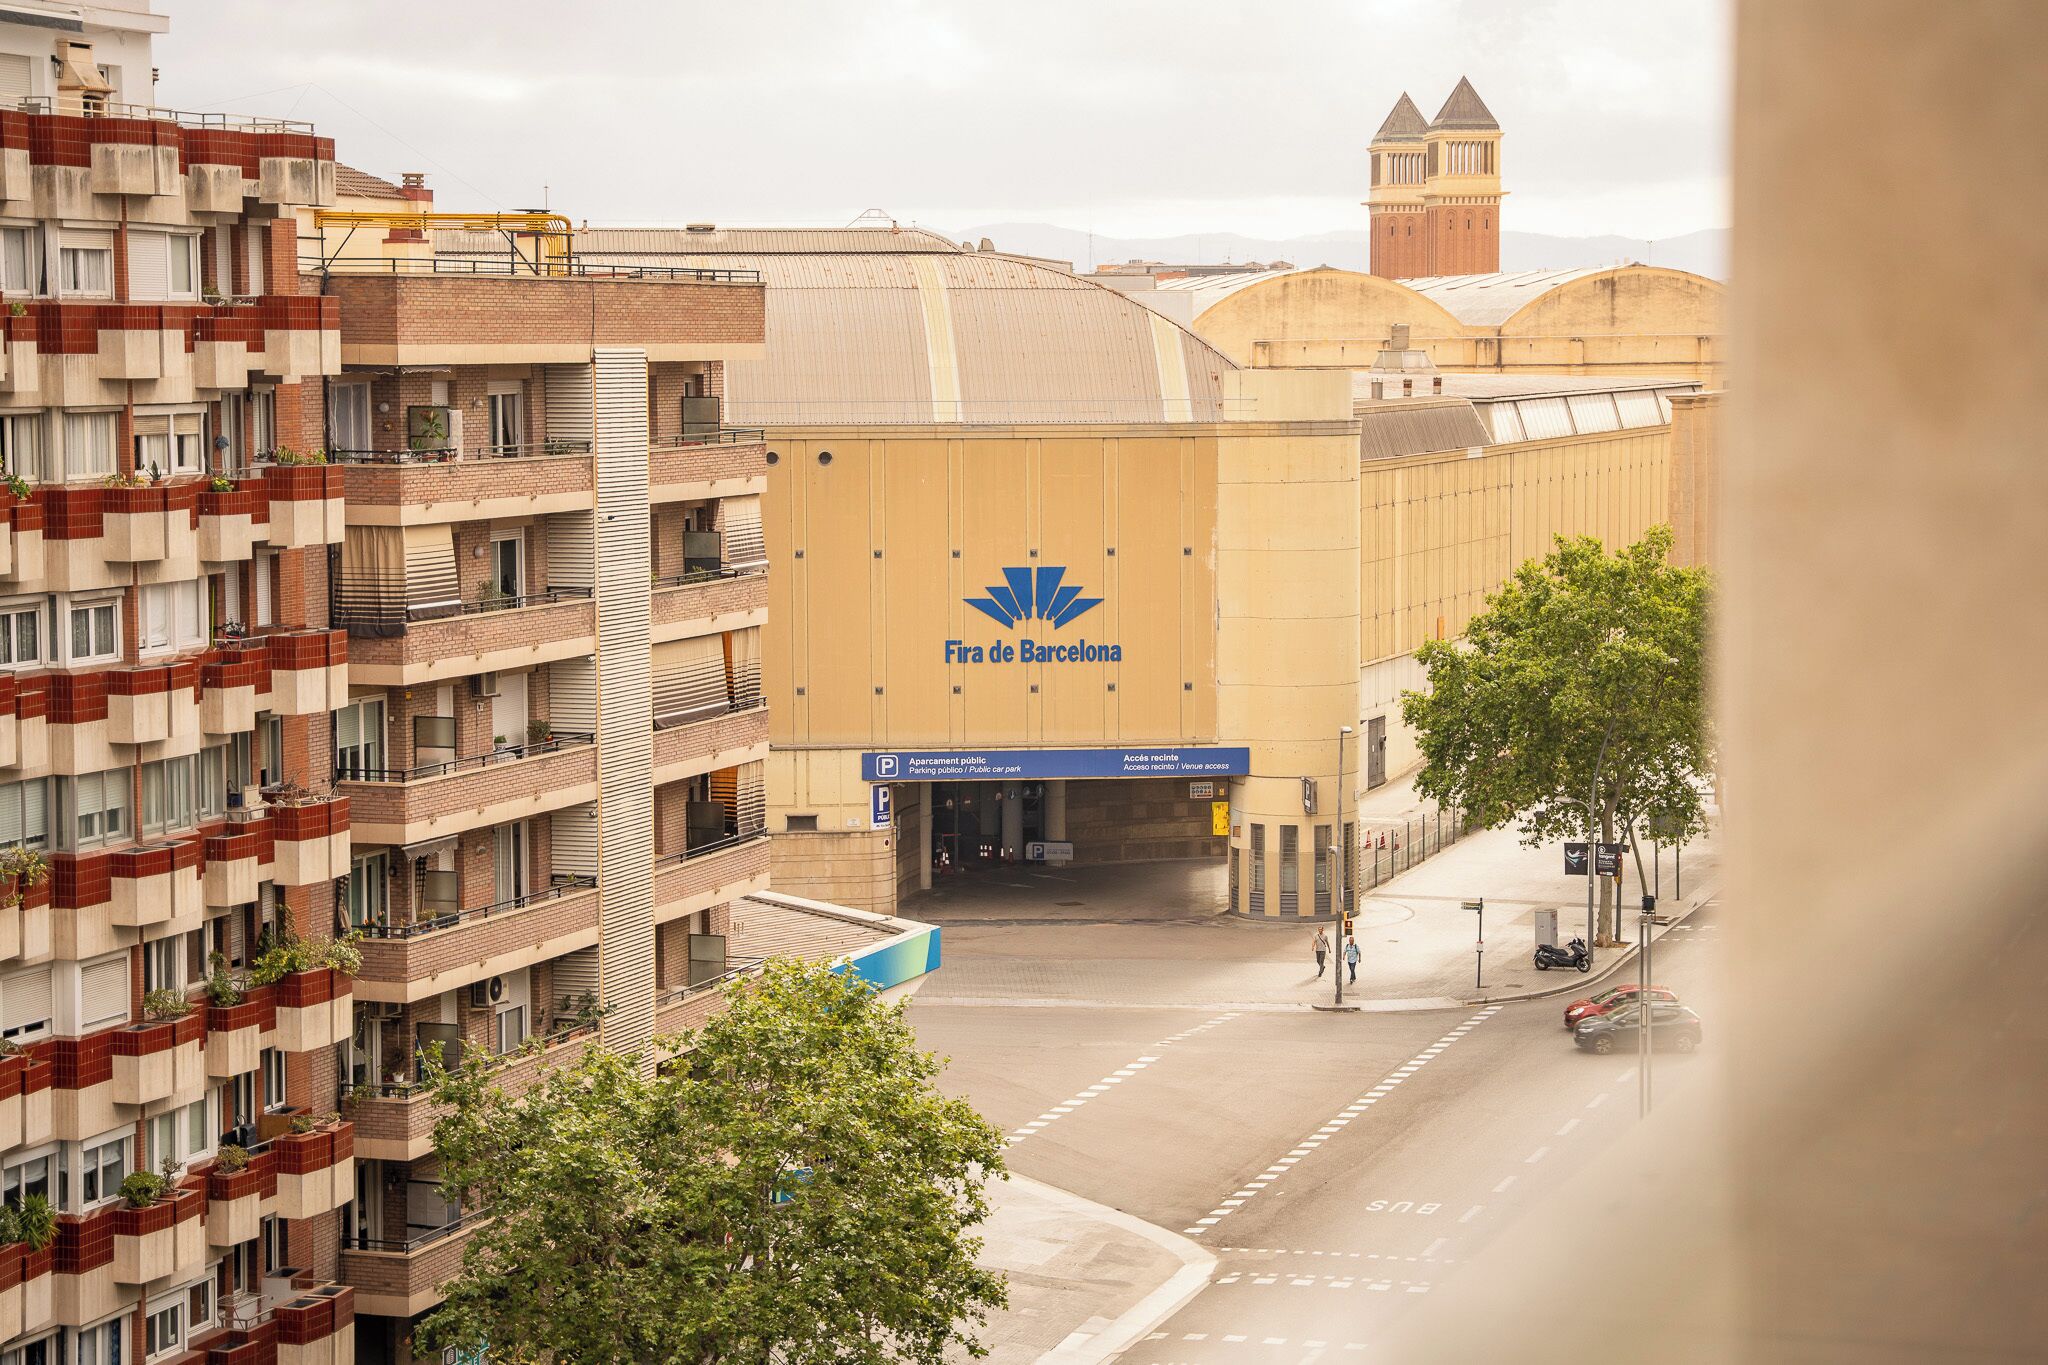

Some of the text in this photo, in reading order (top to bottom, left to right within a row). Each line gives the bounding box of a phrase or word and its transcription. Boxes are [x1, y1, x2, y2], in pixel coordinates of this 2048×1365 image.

[945, 639, 1122, 663] Fira de Barcelona
[909, 756, 987, 767] Aparcament públic
[1123, 753, 1179, 762] Accés recinte
[881, 758, 894, 775] P
[909, 766, 937, 776] Parking
[937, 765, 964, 776] público
[969, 765, 991, 774] Public
[992, 766, 1004, 774] car
[1005, 765, 1021, 775] park
[1123, 762, 1150, 771] Acceso
[1151, 762, 1175, 771] recinto
[1181, 762, 1204, 771] Venue
[1204, 762, 1230, 770] access
[878, 786, 890, 812] P
[1034, 846, 1042, 858] P
[1365, 1200, 1443, 1215] BUS
